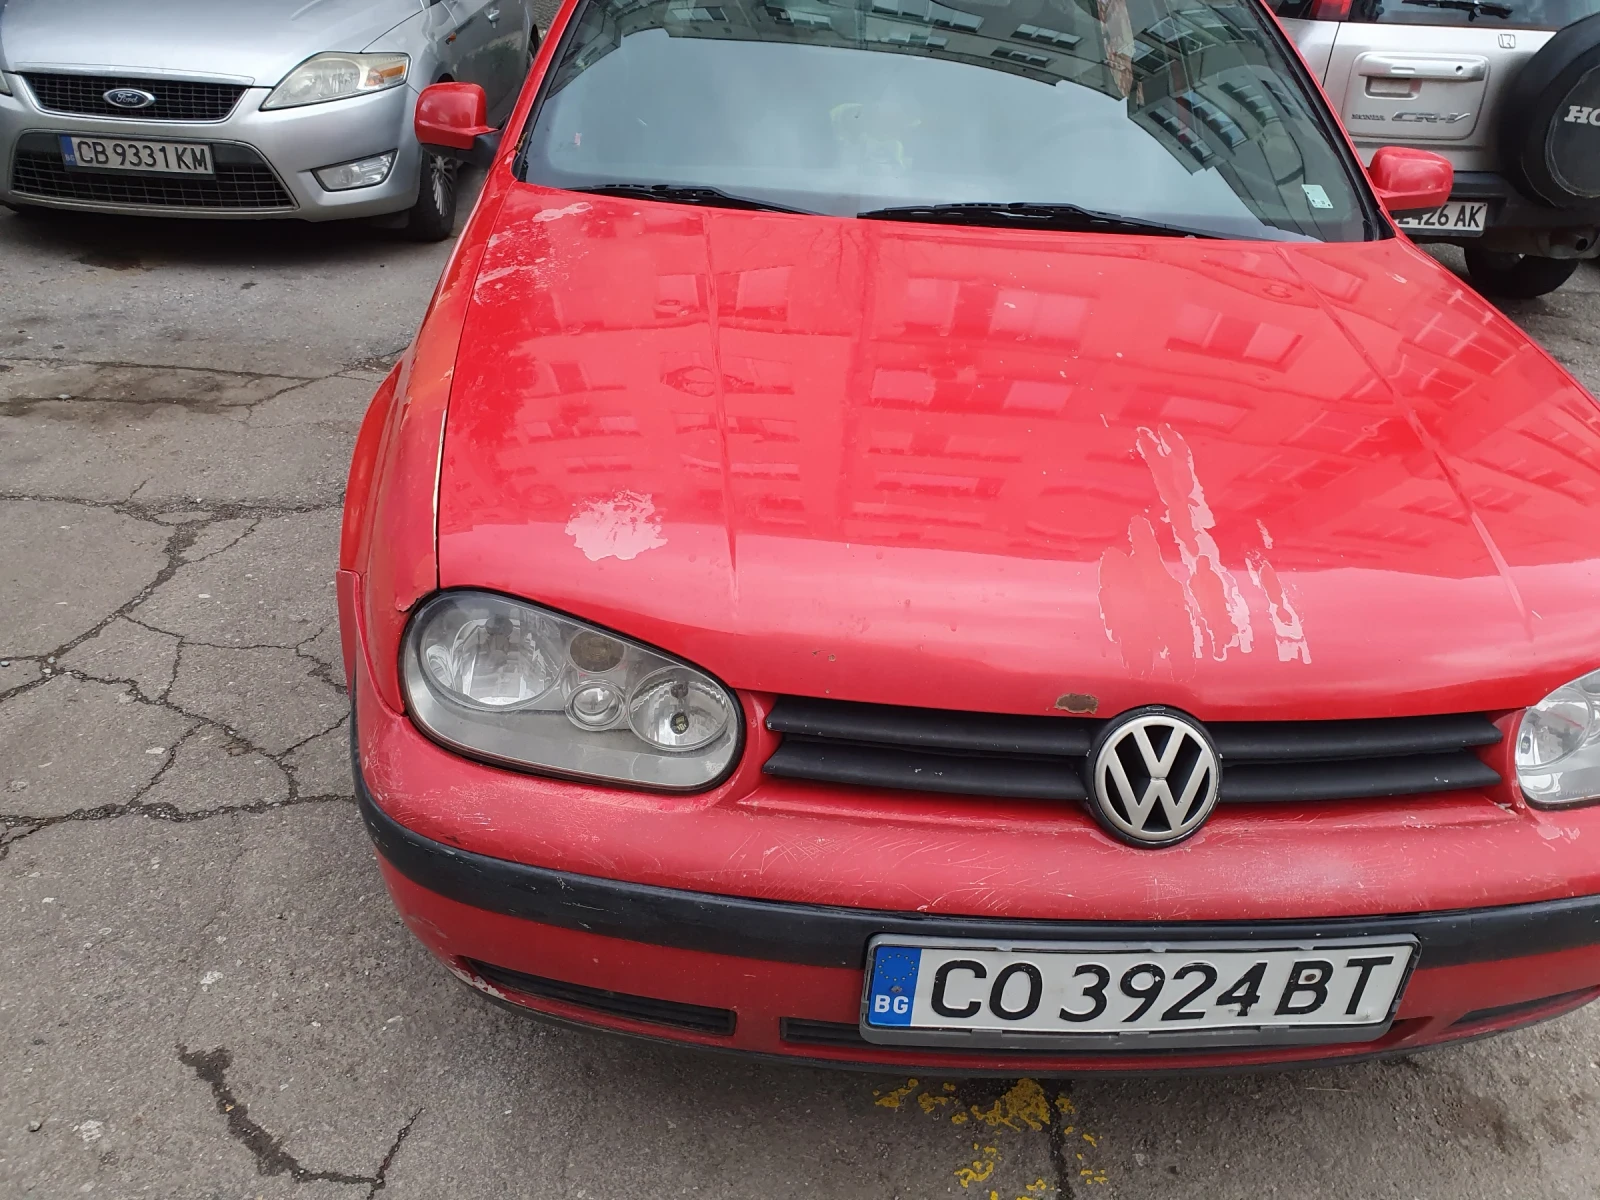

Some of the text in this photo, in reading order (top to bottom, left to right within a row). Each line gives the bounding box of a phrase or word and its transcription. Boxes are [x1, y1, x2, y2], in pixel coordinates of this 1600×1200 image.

[116, 93, 138, 103] Ford
[1391, 111, 1471, 123] CR-V
[77, 140, 208, 171] CB 9331 KM
[1453, 204, 1483, 228] AK
[930, 955, 1394, 1023] CO 3924 BT
[874, 994, 909, 1014] BG
